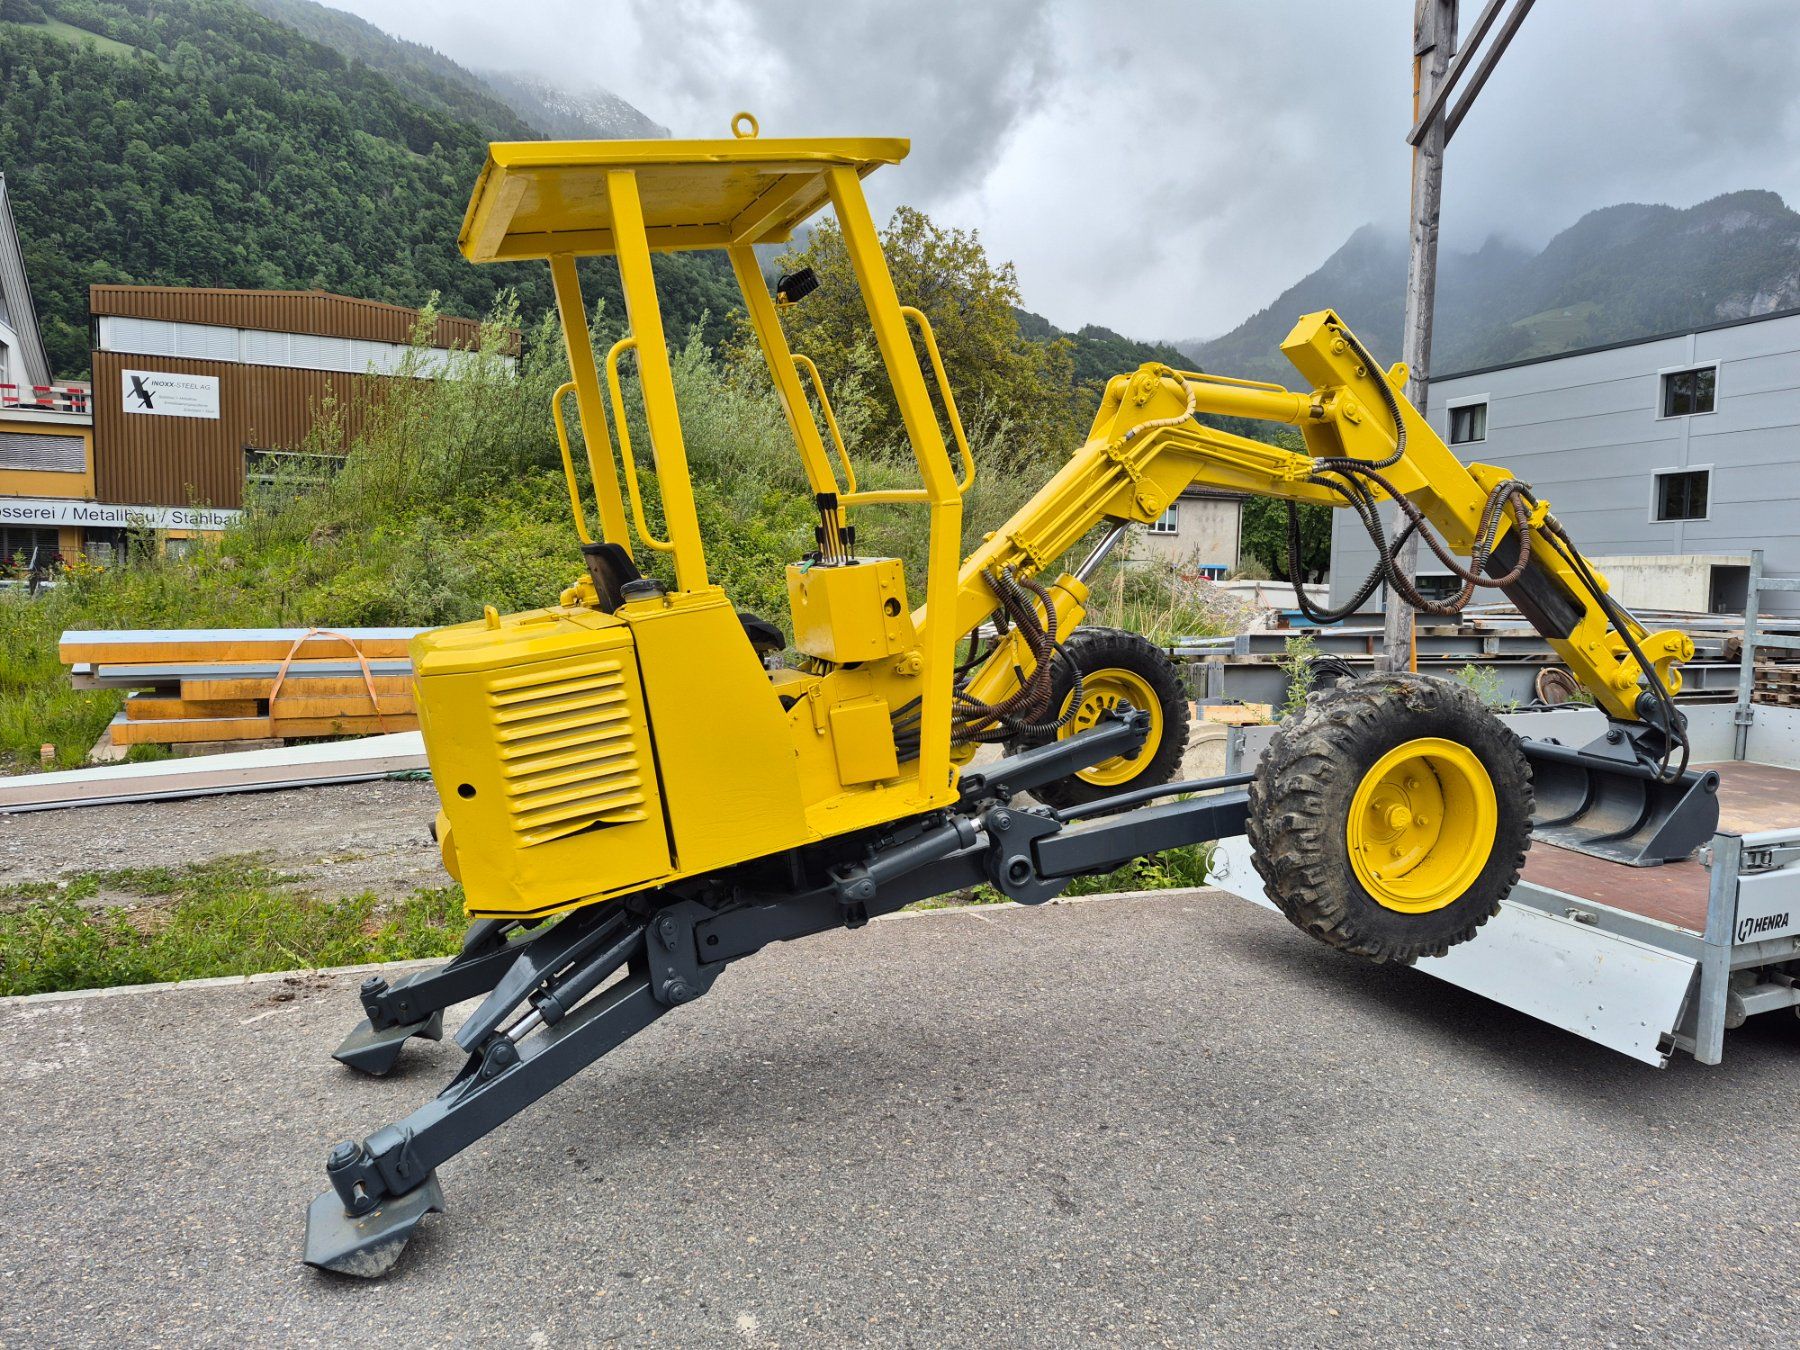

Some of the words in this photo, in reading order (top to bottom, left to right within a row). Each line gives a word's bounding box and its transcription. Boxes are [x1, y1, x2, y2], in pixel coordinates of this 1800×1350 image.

[151, 380, 199, 390] INOXX-STEEL
[0, 506, 55, 519] sserei
[1754, 912, 1789, 933] HENRA
